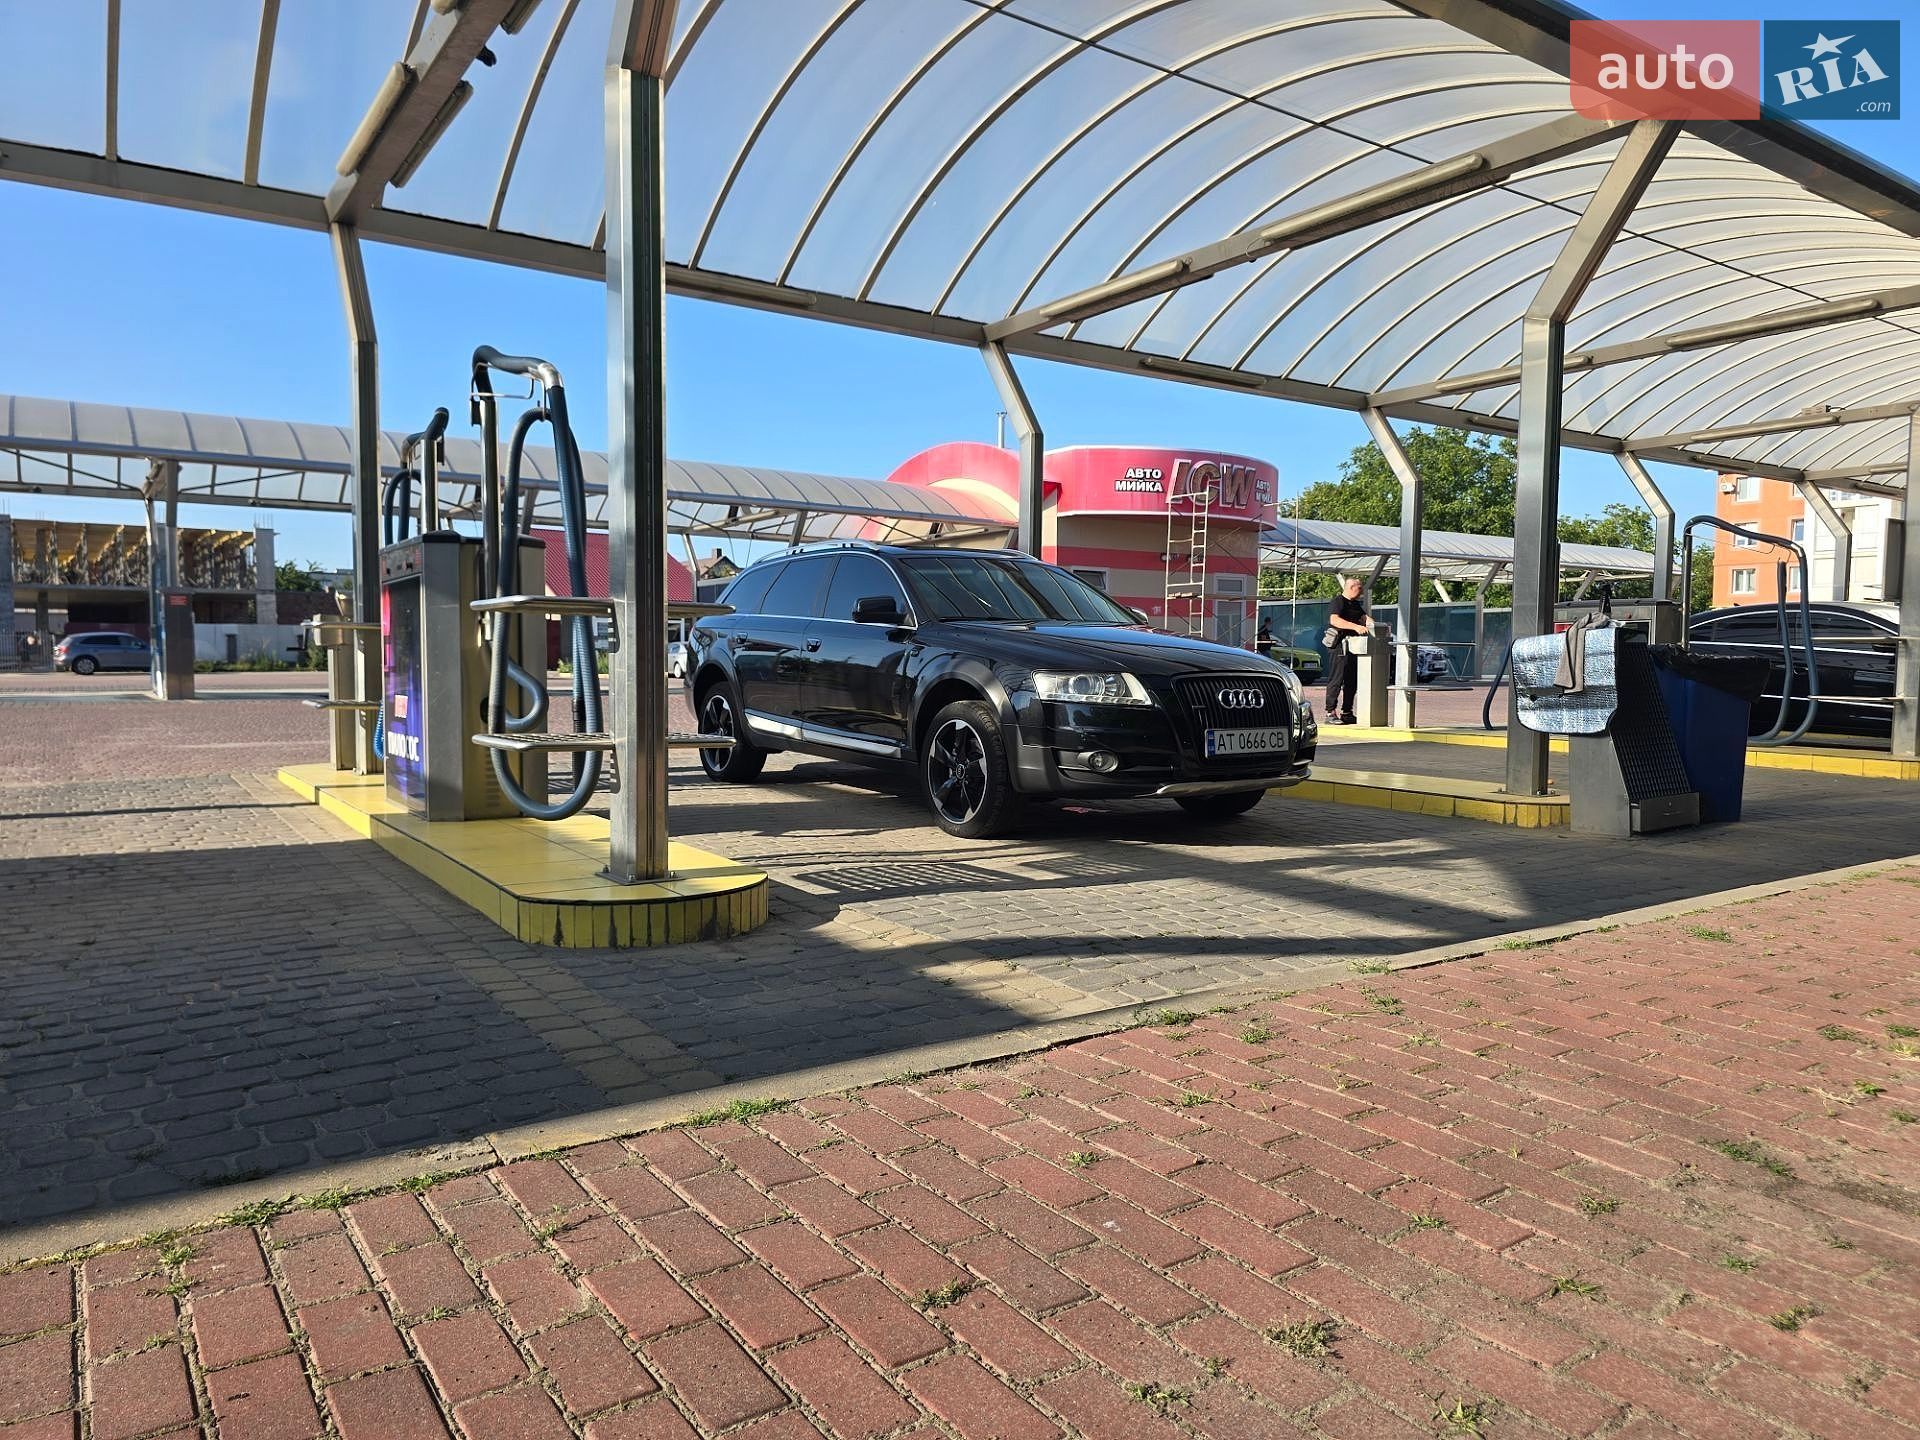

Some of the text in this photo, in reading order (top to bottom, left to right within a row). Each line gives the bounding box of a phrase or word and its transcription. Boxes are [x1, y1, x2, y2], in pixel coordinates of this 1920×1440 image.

[1125, 468, 1163, 480] АВТО
[1115, 479, 1163, 492] МИЙКА
[1217, 731, 1285, 751] AT 0666 CB
